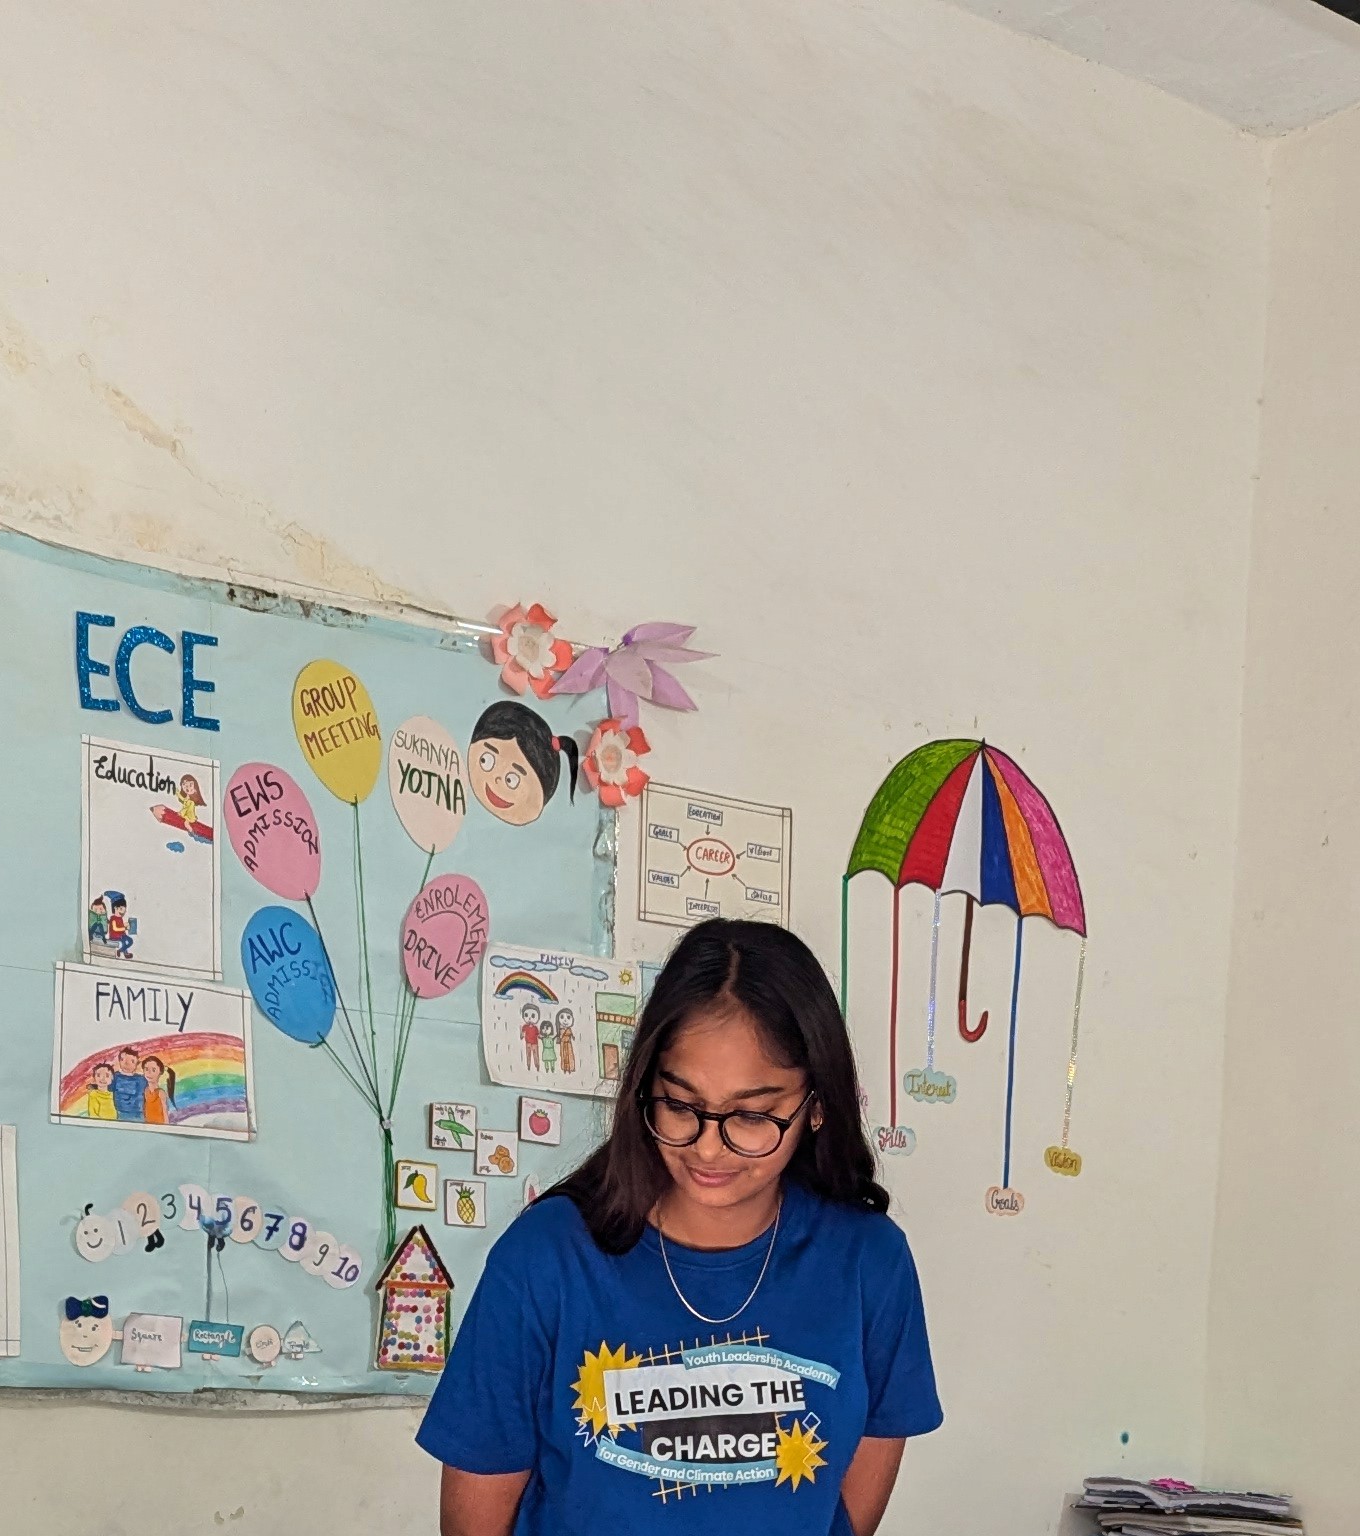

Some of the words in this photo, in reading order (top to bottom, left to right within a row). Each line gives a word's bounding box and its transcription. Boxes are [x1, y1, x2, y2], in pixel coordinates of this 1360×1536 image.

[76, 611, 220, 732] ECE
[300, 676, 357, 719] GROUP
[303, 712, 382, 760] MEETING
[395, 730, 461, 775] SUKANYA
[94, 753, 178, 797] Education
[230, 771, 284, 818] EWS
[398, 758, 466, 816] YOJNA
[243, 809, 319, 873] ADMISSION
[695, 845, 731, 865] CAREER
[248, 922, 302, 974] AWC
[404, 929, 460, 989] DRIVE
[540, 954, 575, 967] FAMILY
[96, 982, 194, 1032] FAMILY
[878, 1126, 907, 1152] Skills
[1049, 1151, 1078, 1171] Vision
[991, 1190, 1019, 1212] Goals
[136, 1203, 155, 1228] 2
[161, 1194, 177, 1220] 3
[188, 1194, 202, 1221] 4
[214, 1197, 233, 1226] 5
[240, 1205, 258, 1232] 6
[264, 1213, 285, 1242] 7
[289, 1222, 307, 1251] 8
[313, 1244, 330, 1267] 9
[332, 1256, 360, 1283] 10
[194, 1329, 236, 1348] Rectangle
[686, 1351, 721, 1368] Youth
[722, 1349, 782, 1369] Leadership
[783, 1358, 837, 1385] Academy
[614, 1383, 744, 1416] LEADING
[751, 1380, 805, 1405] THE
[599, 1446, 617, 1461] for
[617, 1453, 661, 1476] Gender
[661, 1465, 685, 1480] and
[686, 1468, 734, 1482] Climate
[735, 1466, 775, 1481] Action
[650, 1433, 777, 1462] CHARGE
